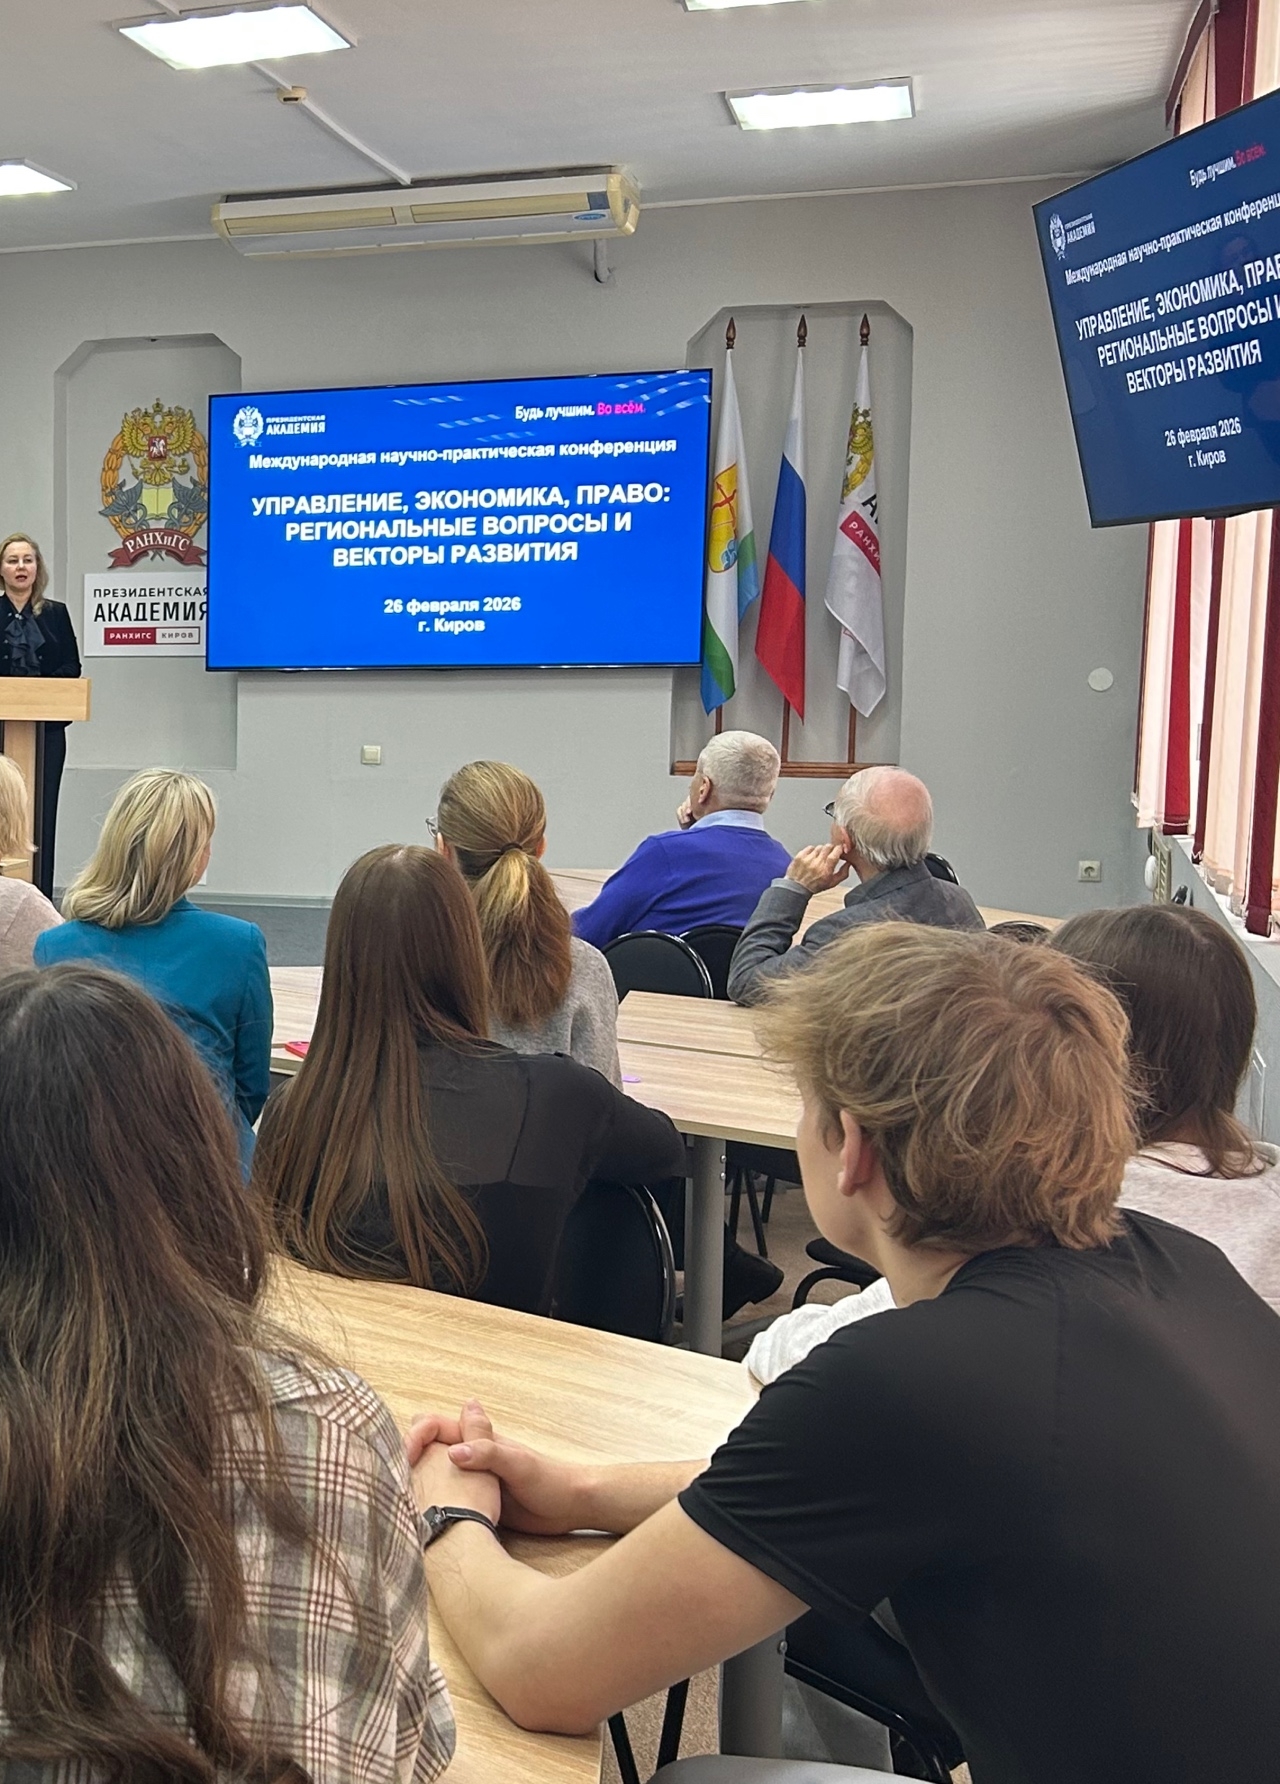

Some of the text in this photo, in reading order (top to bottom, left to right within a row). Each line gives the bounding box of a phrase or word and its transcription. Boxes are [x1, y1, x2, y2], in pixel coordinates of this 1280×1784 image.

[1065, 250, 1127, 285] Международная
[1128, 215, 1223, 264] научно-практическая
[1075, 296, 1155, 341] УПРАВЛЕНИЕ,
[1155, 268, 1243, 316] ЭКОНОМИКА,
[1097, 318, 1197, 368] РЕГИОНАЛЬНЫЕ
[1197, 296, 1273, 340] ВОПРОСЫ
[1126, 338, 1262, 394] ВЕКТОРЫ РАЗВИТИЯ
[515, 405, 543, 422] Будь
[544, 405, 595, 421] лучшим.
[597, 402, 612, 416] Во
[266, 422, 326, 435] АКАДЕМИЯ
[1165, 416, 1242, 448] 26 февраля 2026
[249, 439, 676, 471] Международная научно-практическая конференция
[1188, 449, 1227, 469] г. Киров
[252, 482, 671, 517] УПРАВЛЕНИЕ, ЭКОНОМИКА, ПРАВО:
[285, 511, 631, 541] РЕГИОНАЛЬНЫЕ ВОПРОСЫ И
[125, 531, 191, 553] РАНХиГС
[333, 541, 578, 567] ВЕКТОРЫ РАЗВИТИЯ
[93, 601, 207, 622] АКАДЕМИЯ
[383, 596, 522, 616] 26 февраля 2026
[109, 632, 152, 640] РАНХИГС
[418, 618, 485, 635] г. Киров
